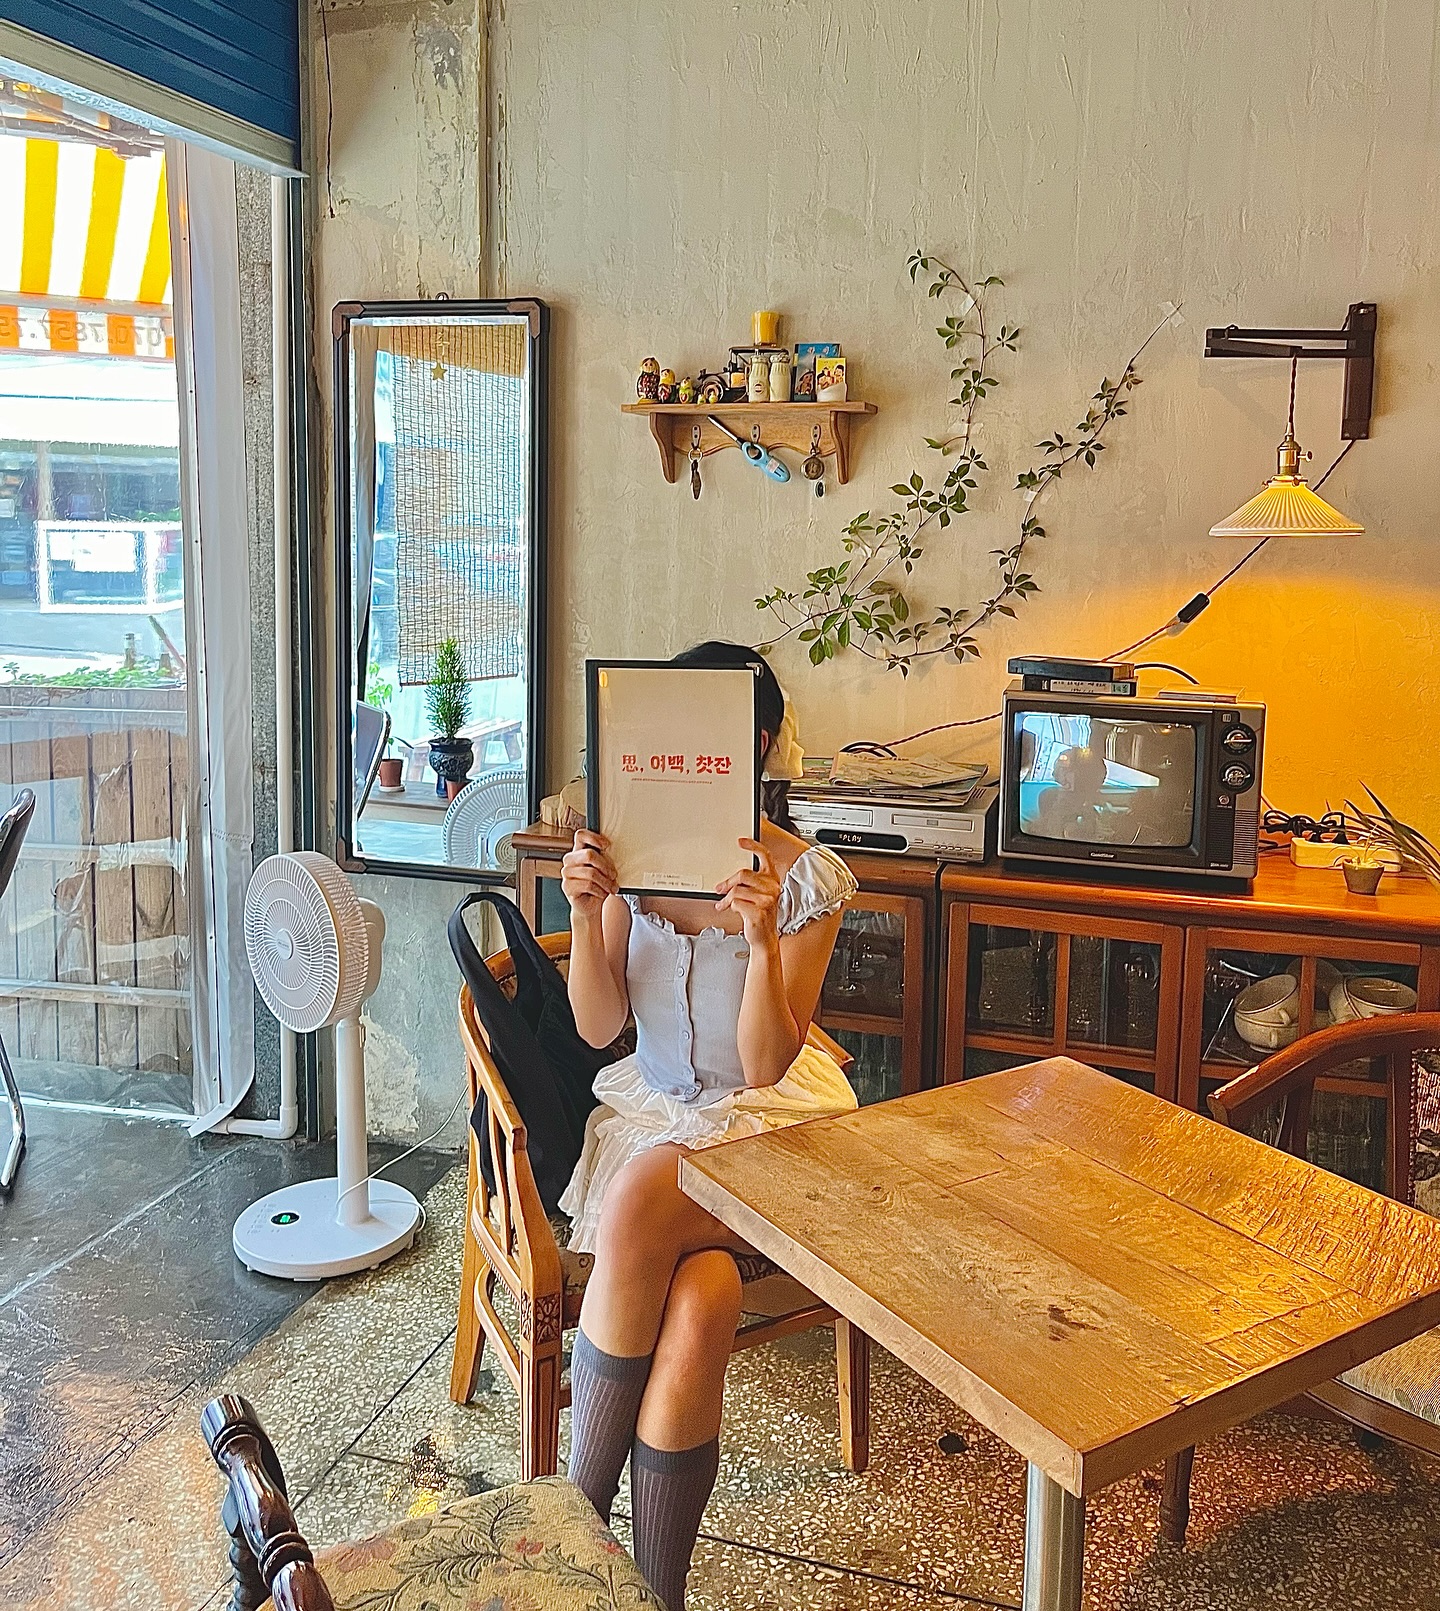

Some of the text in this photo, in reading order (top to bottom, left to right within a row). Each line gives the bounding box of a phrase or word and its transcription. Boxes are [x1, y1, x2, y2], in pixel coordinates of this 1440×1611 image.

[622, 754, 732, 775] 思, 여백, 찻잔
[842, 833, 862, 843] PLAY
